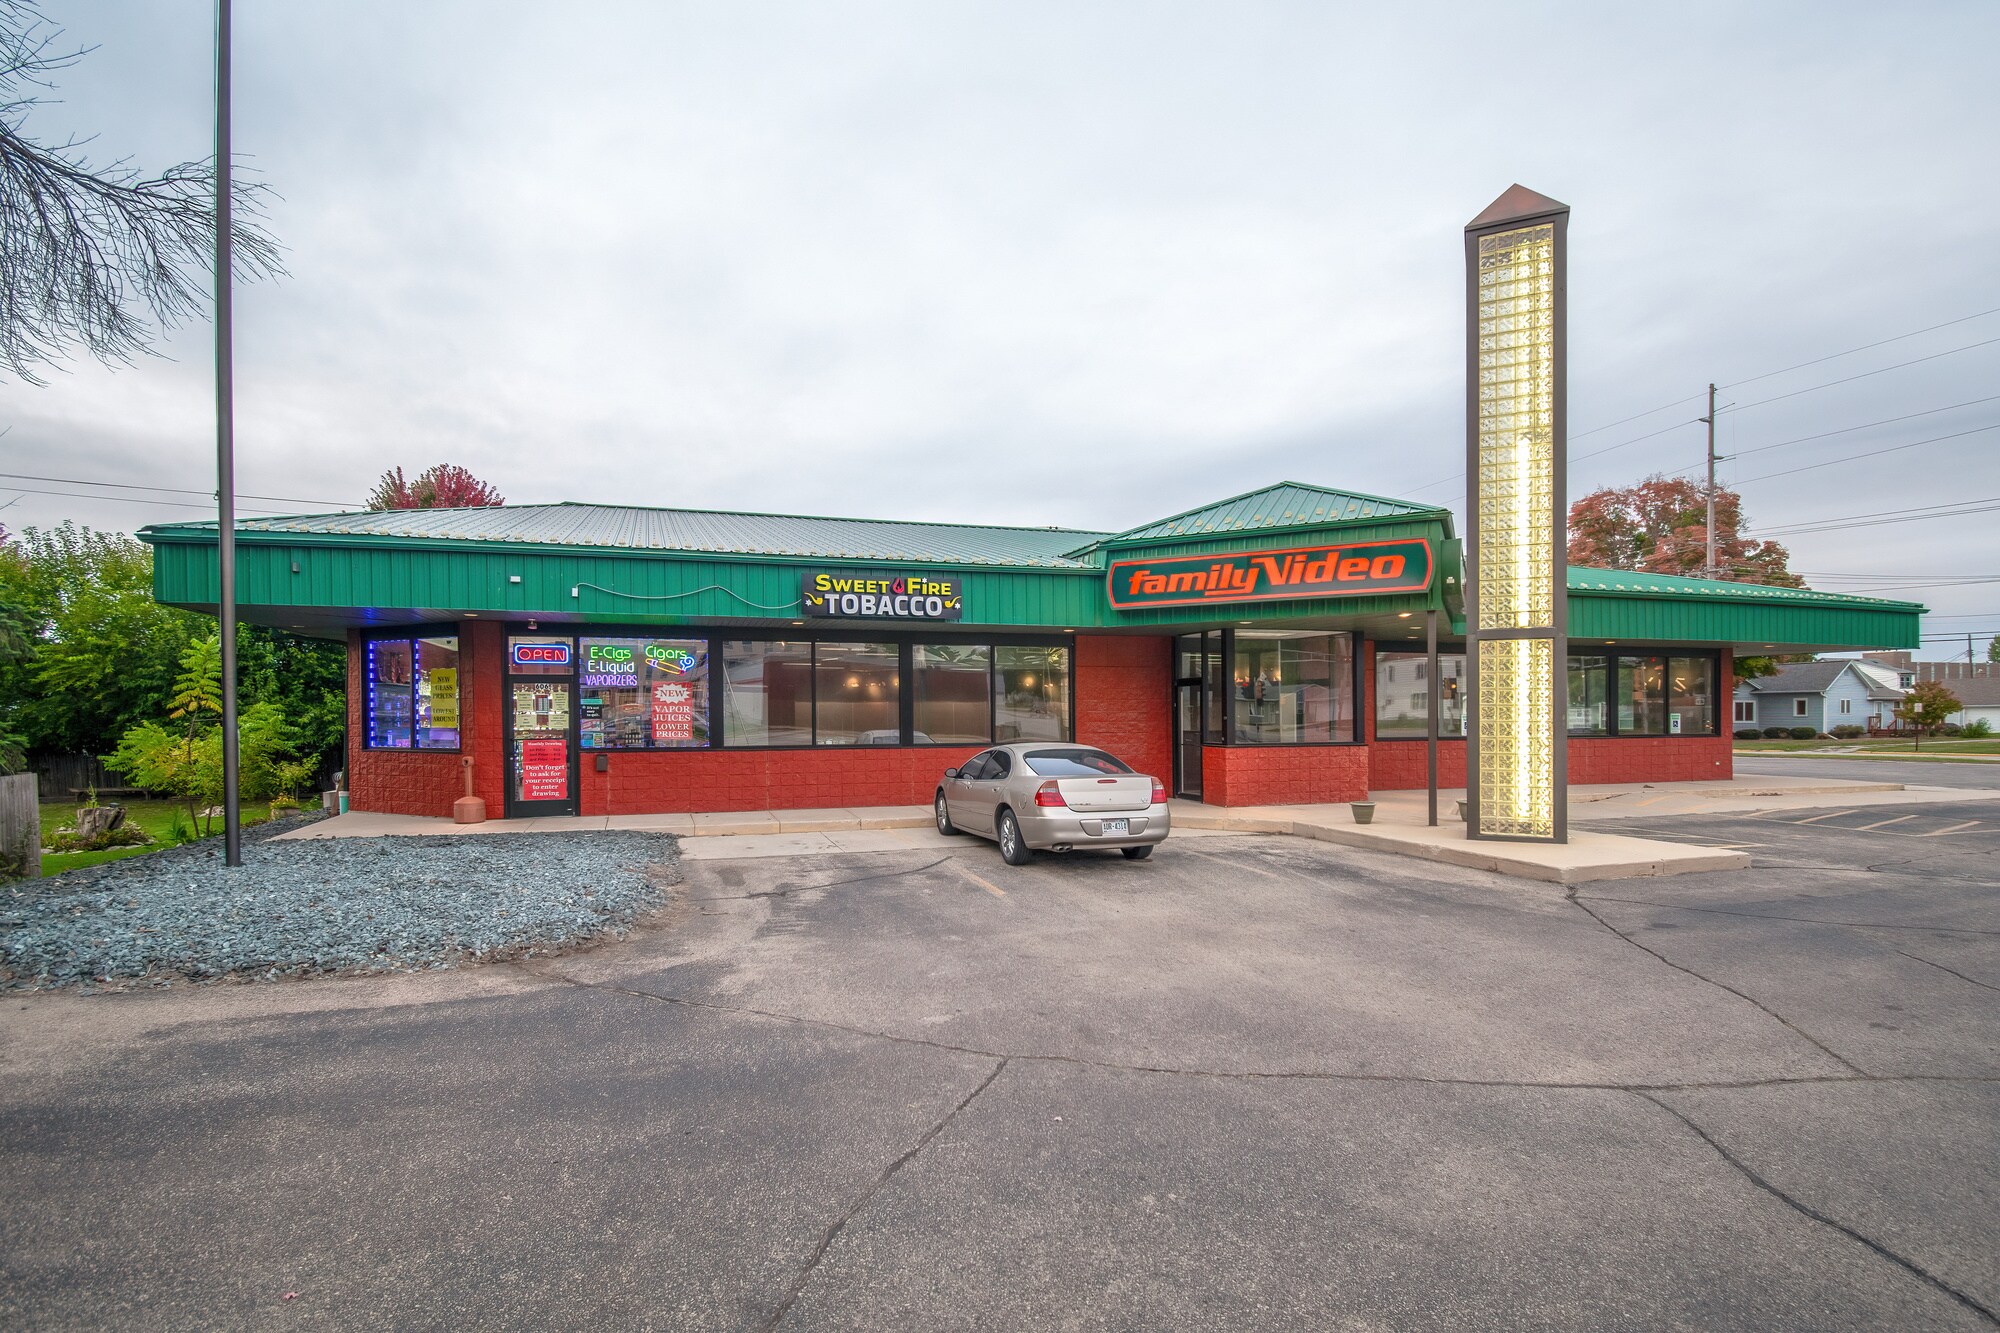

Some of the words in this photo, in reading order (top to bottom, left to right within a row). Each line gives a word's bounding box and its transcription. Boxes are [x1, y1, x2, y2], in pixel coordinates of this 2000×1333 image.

[1128, 563, 1260, 596] family
[1250, 551, 1407, 586] Video
[815, 573, 890, 593] SWEET
[907, 576, 951, 596] FIRE
[824, 593, 943, 617] TOBACCO
[518, 648, 566, 662] OPEN
[590, 647, 631, 661] E-Cigs
[645, 646, 686, 660] Cigars
[588, 660, 635, 674] E-Liquid
[585, 675, 637, 686] VAPORIZERS
[660, 689, 686, 697] NEW
[654, 705, 690, 713] VAPOR
[653, 713, 691, 721] JUICES
